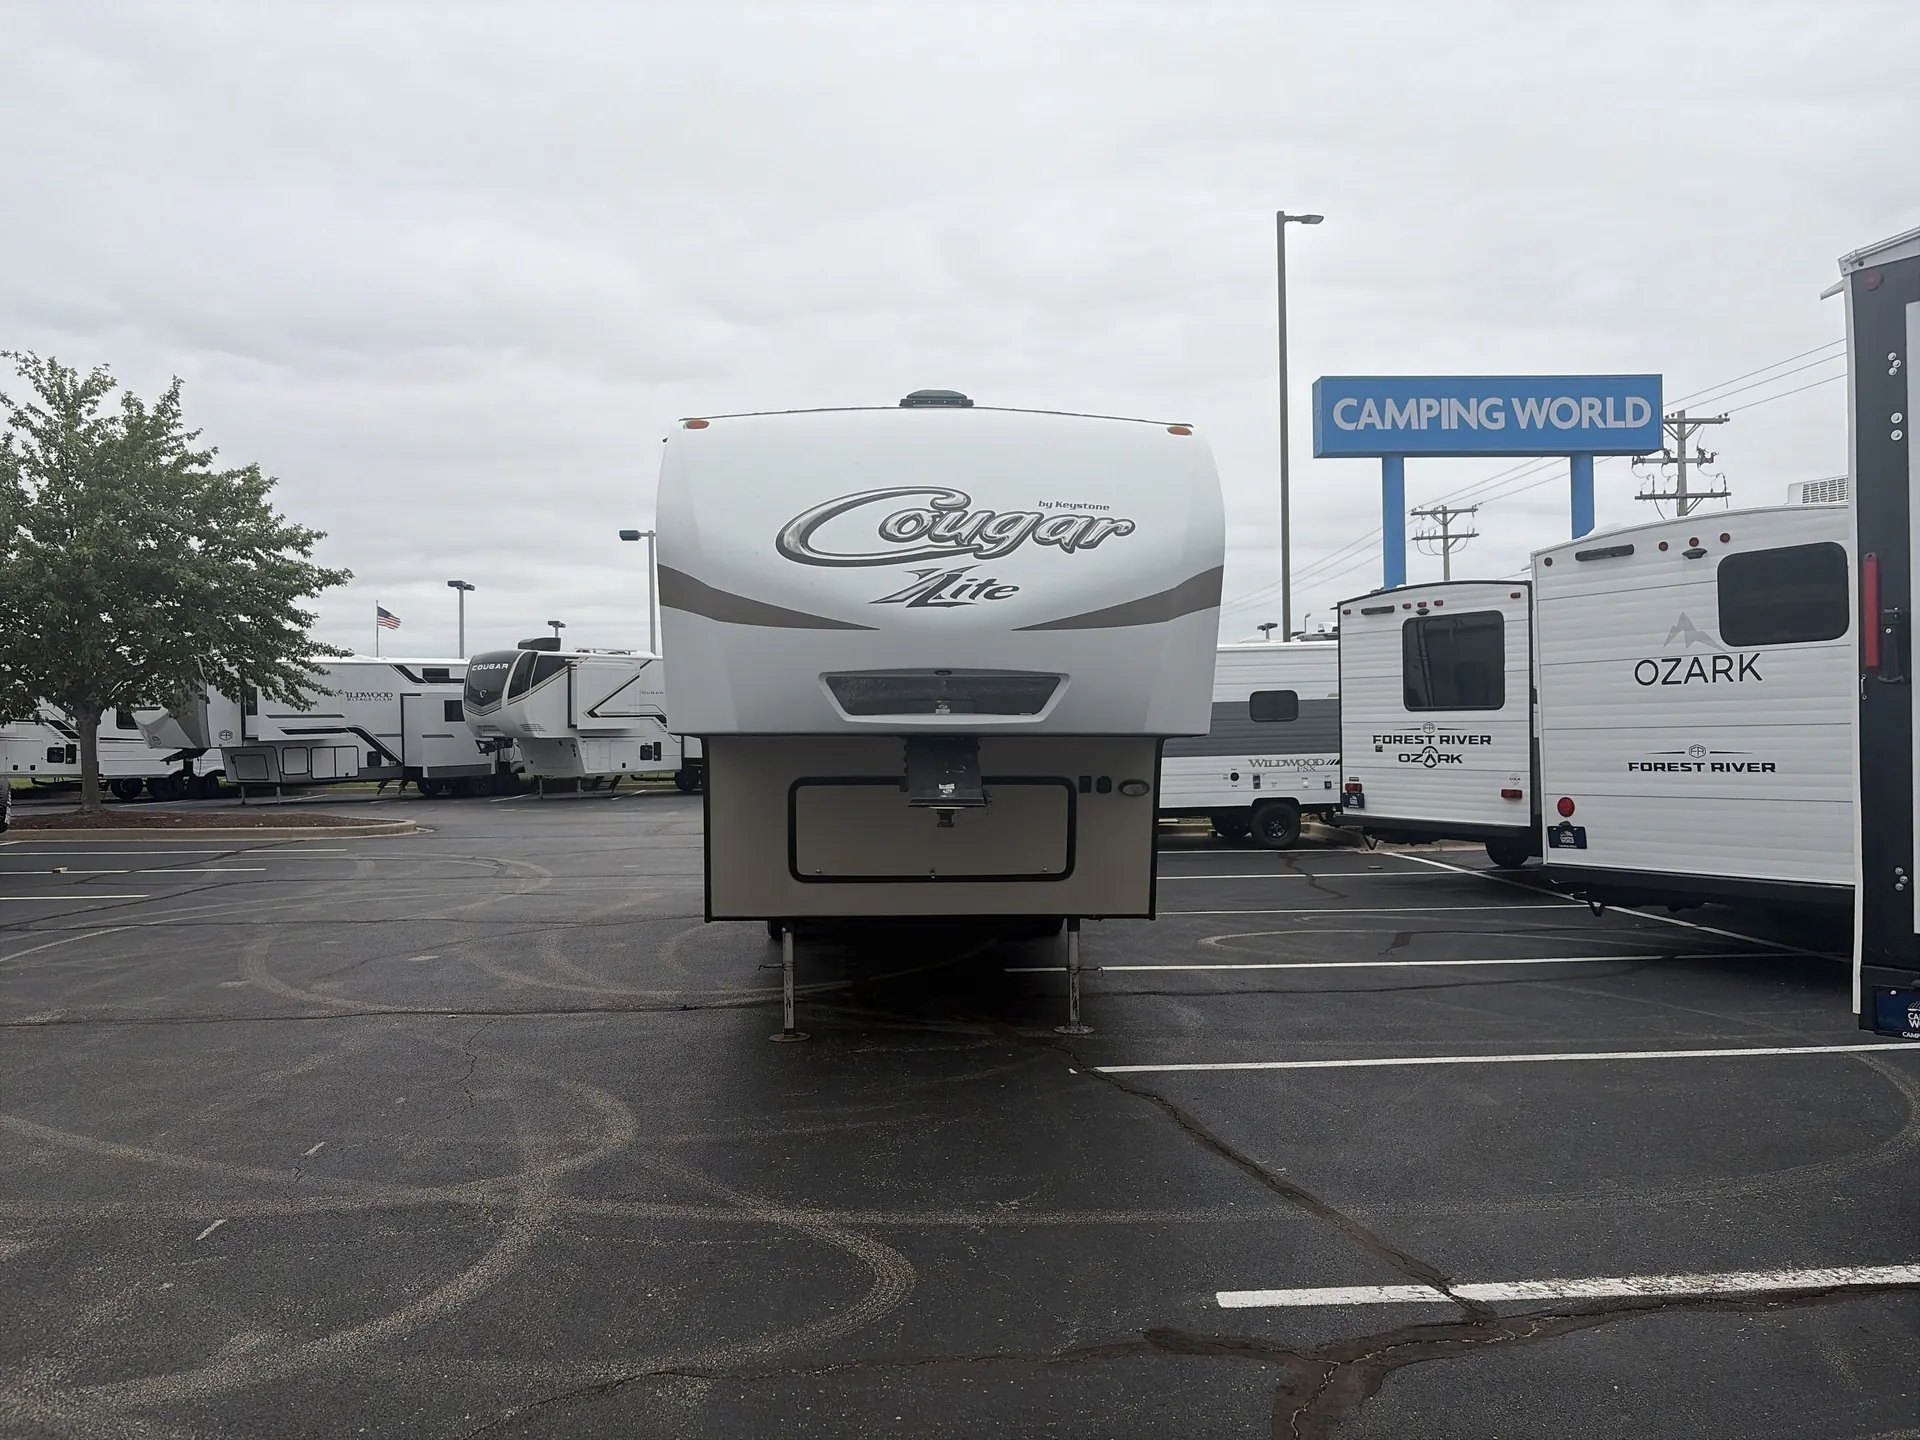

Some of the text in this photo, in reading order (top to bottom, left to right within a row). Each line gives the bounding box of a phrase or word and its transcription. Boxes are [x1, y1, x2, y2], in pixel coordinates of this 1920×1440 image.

[1333, 397, 1652, 430] CAMPING WORLD
[1038, 500, 1110, 511] by Keystone
[775, 485, 1136, 567] Cougar
[472, 663, 509, 671] COUGAR
[1634, 653, 1763, 686] OZARK
[1372, 735, 1492, 745] FOREST RIVER
[1398, 746, 1463, 768] OZARK
[1248, 759, 1325, 767] WILDWOOD
[1628, 762, 1776, 773] FOREST RIVER
